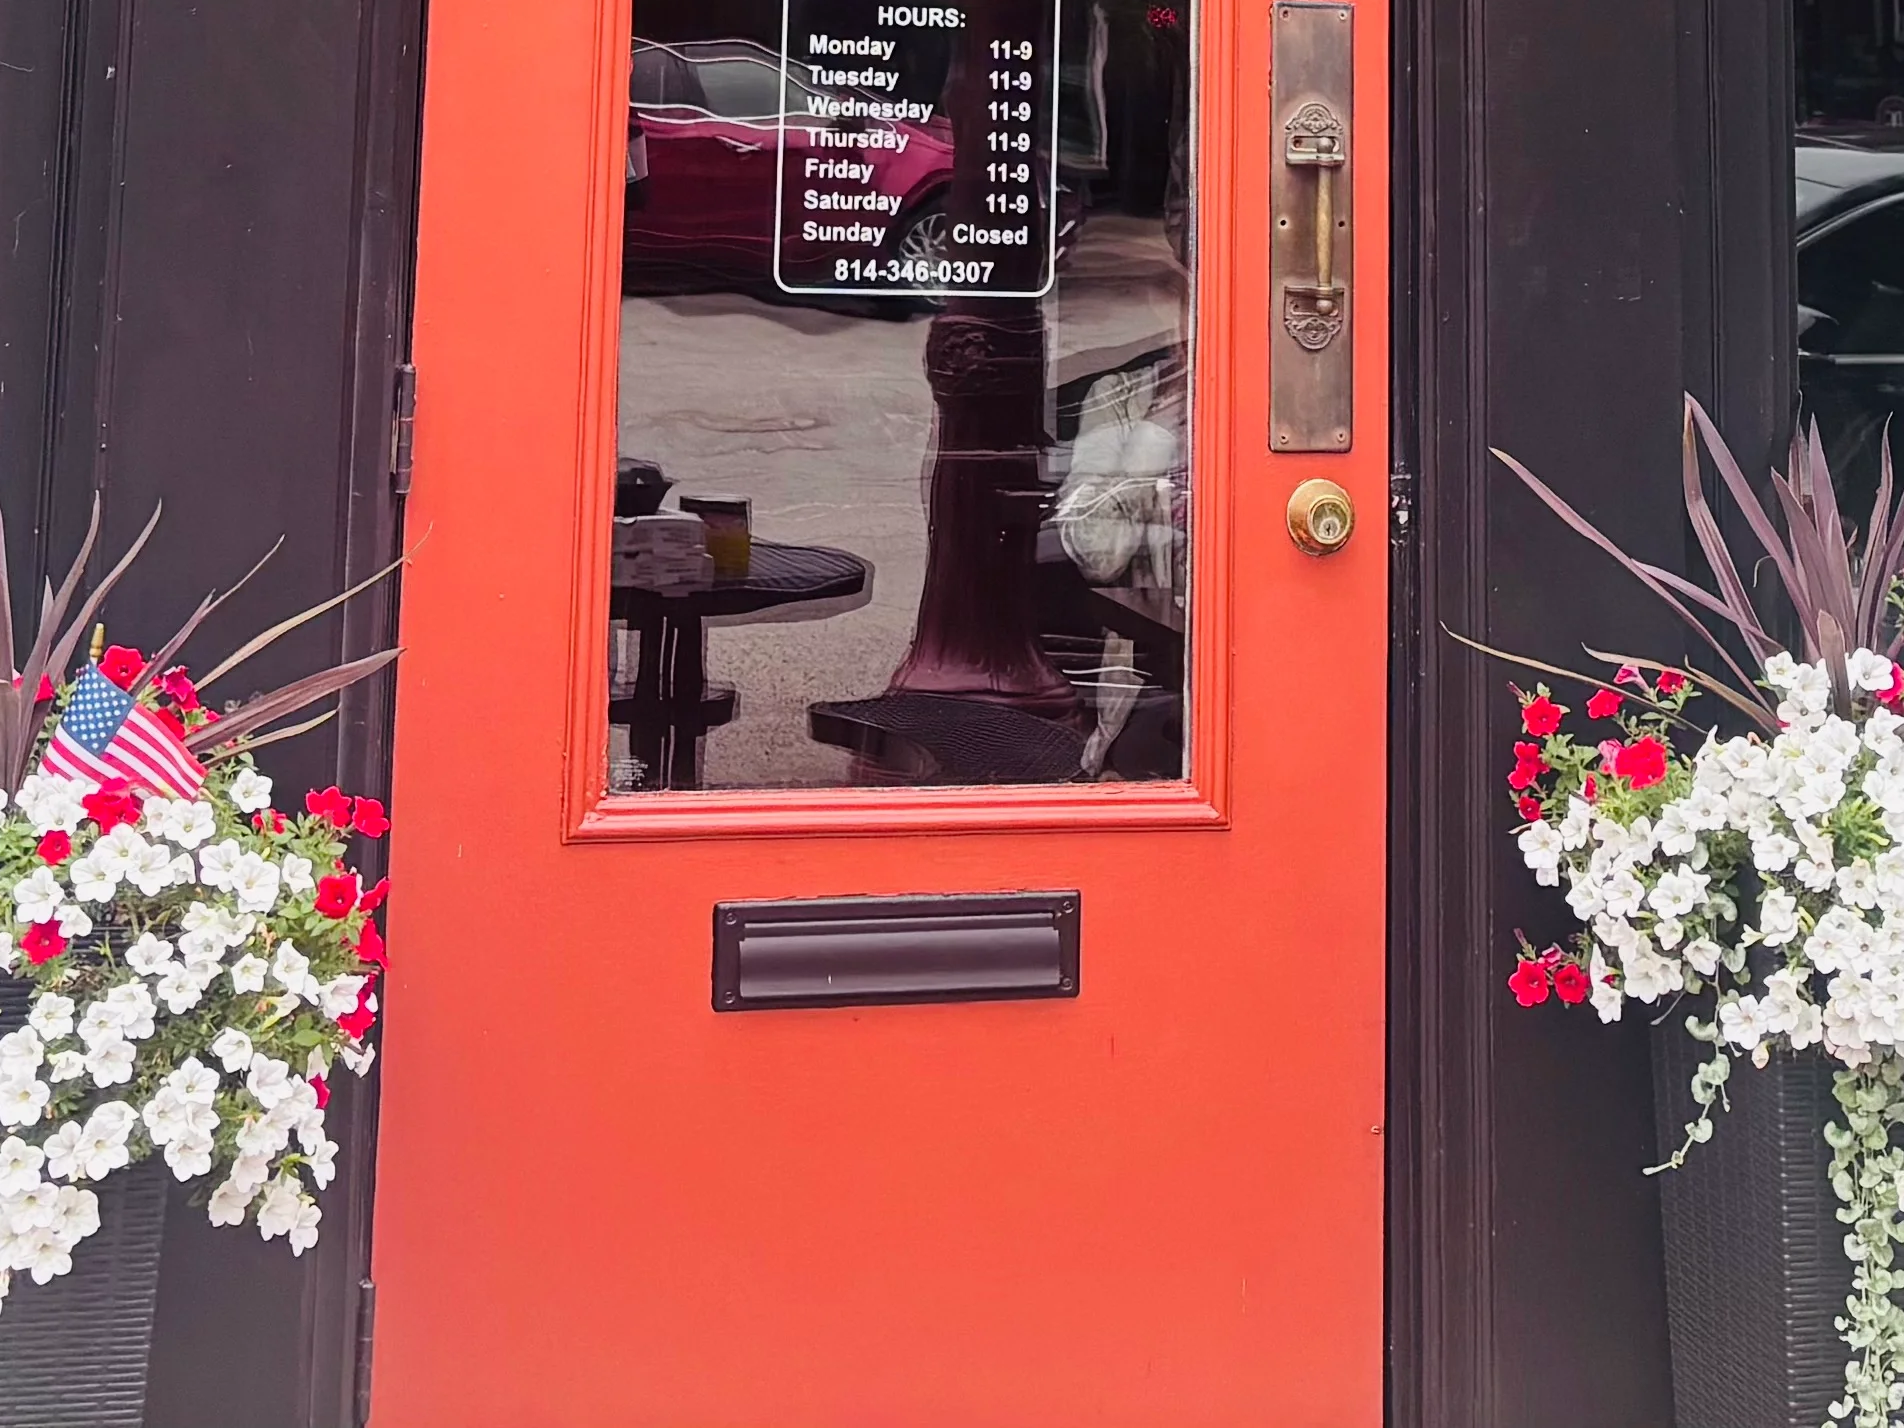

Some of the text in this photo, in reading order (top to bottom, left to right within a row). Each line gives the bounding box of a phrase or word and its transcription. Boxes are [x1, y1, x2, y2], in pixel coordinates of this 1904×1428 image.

[877, 5, 966, 29] HOURS:
[809, 34, 1033, 61] Monday 11-9
[809, 65, 1033, 92] Tuesday 11-9
[807, 95, 1032, 123] Wednesday 11-9
[805, 126, 1031, 154] Thursday 11-9
[805, 158, 1030, 183] Friday 11-9
[803, 189, 1029, 216] Saturday 11-9
[802, 220, 1029, 247] Sunday Closed
[834, 258, 995, 284] 814-346-0307
